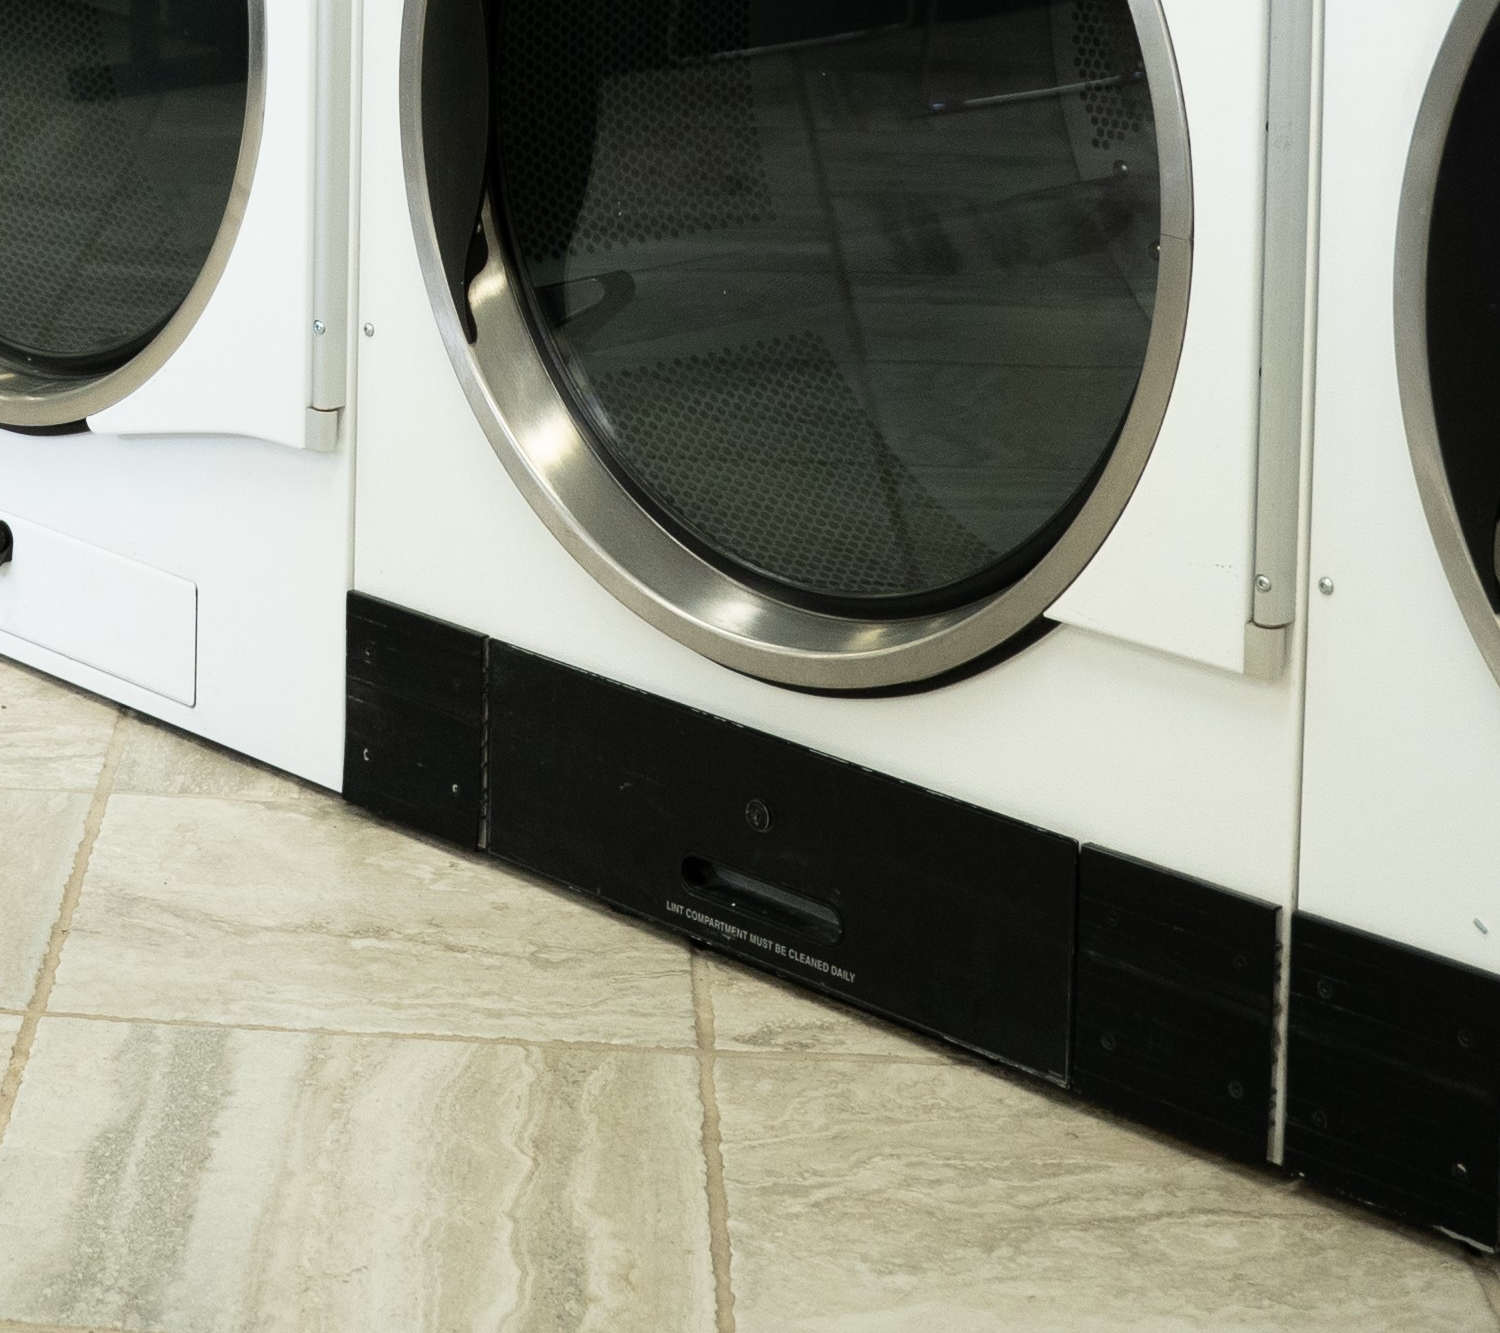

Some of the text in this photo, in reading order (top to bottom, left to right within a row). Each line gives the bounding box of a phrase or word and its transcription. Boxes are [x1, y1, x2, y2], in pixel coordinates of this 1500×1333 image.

[666, 900, 856, 983] LINT COMPARTMENT MUST BE CLEANED DAILY
